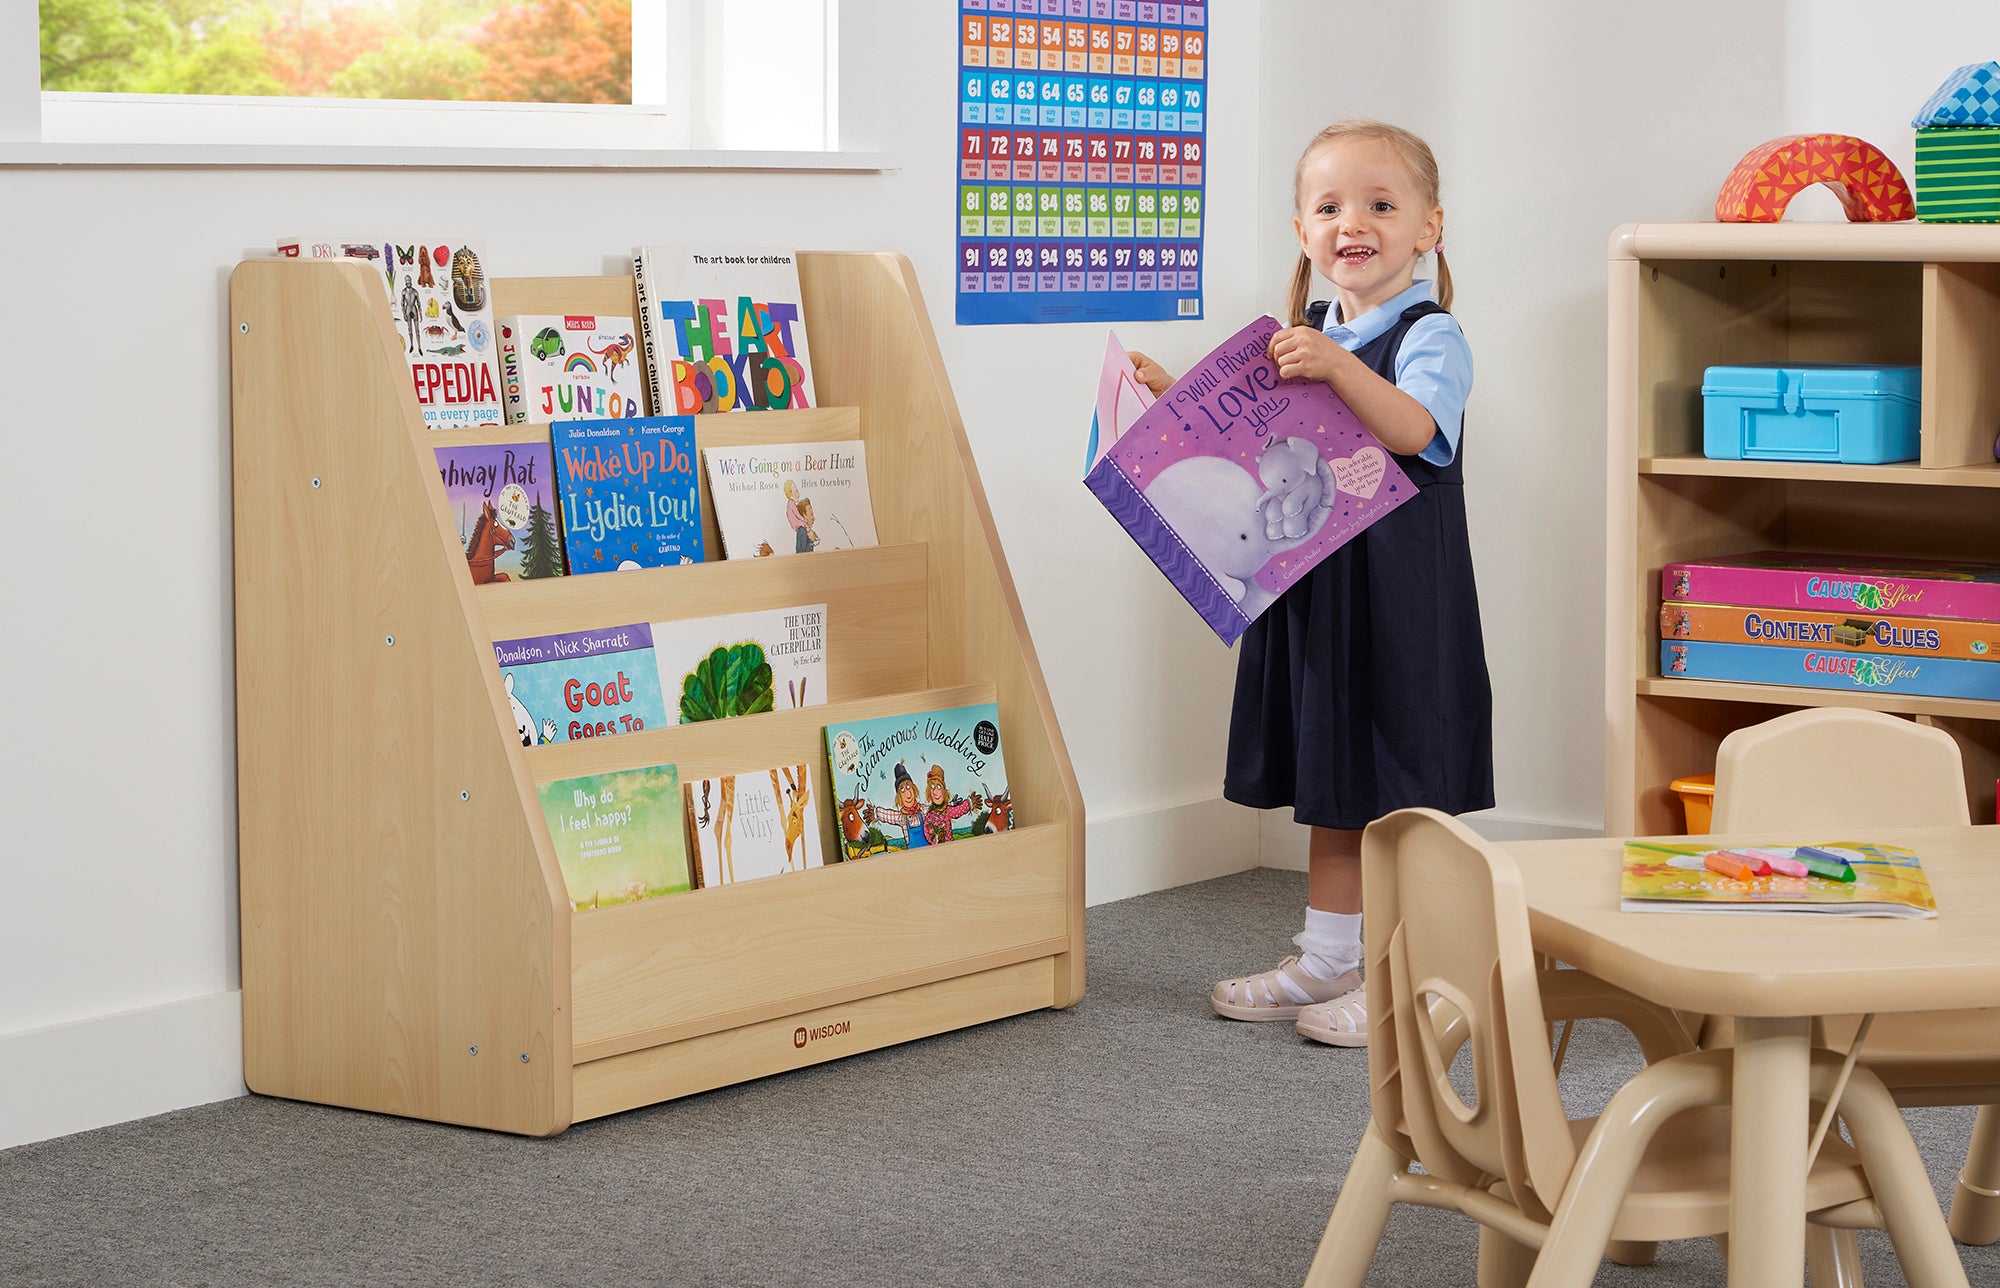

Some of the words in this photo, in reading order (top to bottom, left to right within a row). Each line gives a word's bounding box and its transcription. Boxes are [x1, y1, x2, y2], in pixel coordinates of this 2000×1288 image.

[969, 22, 981, 40] 51
[993, 24, 1010, 42] 52
[1019, 26, 1035, 43] 53
[1044, 27, 1060, 45] 54
[1069, 29, 1084, 47] 55
[1093, 31, 1109, 48] 56
[1118, 32, 1132, 50] 57
[1140, 34, 1155, 51] 58
[1164, 36, 1178, 52] 59
[1185, 37, 1202, 54] 60
[968, 79, 980, 96] 61
[992, 80, 1009, 98] 62
[1017, 82, 1034, 99] 63
[1042, 83, 1060, 100] 64
[1068, 84, 1083, 102] 65
[1092, 86, 1108, 102] 66
[1116, 87, 1130, 103] 67
[1139, 88, 1154, 105] 68
[1162, 90, 1177, 106] 69
[1185, 91, 1200, 107] 70
[968, 136, 980, 153] 71
[992, 136, 1007, 154] 72
[1017, 137, 1033, 155] 73
[1043, 139, 1057, 155] 74
[1067, 140, 1082, 157] 75
[1091, 140, 1106, 157] 76
[1115, 142, 1130, 158] 77
[1139, 142, 1153, 159] 78
[1162, 143, 1177, 159] 79
[1184, 143, 1200, 161] 80
[967, 192, 979, 210] 81
[990, 192, 1007, 210] 82
[1016, 193, 1032, 211] 83
[1041, 194, 1058, 211] 84
[1066, 194, 1082, 212] 85
[1090, 195, 1107, 212] 86
[1115, 195, 1130, 212] 87
[1139, 196, 1154, 212] 88
[1162, 196, 1177, 213] 89
[1184, 197, 1199, 213] 90
[634, 256, 643, 280] The
[693, 255, 708, 264] The
[711, 256, 723, 264] art
[725, 255, 745, 264] book
[747, 255, 758, 264] for
[760, 255, 791, 264] children
[966, 249, 978, 266] 91
[990, 248, 1007, 266] 92
[1016, 249, 1032, 266] 93
[1041, 249, 1058, 266] 94
[1066, 249, 1082, 267] 95
[1090, 249, 1107, 266] 96
[1115, 249, 1131, 265] 97
[1139, 249, 1154, 266] 98
[1161, 249, 1175, 265] 99
[1180, 250, 1197, 266] 100
[638, 283, 646, 302] art
[641, 306, 651, 339] book
[661, 298, 732, 362] THE
[738, 296, 798, 358] ART
[645, 340, 654, 361] for
[504, 345, 520, 404] JUNIOR
[671, 354, 755, 415] BOOK
[748, 352, 810, 410] FOR
[542, 384, 637, 419] JUNIOR
[649, 364, 661, 414] children
[1166, 402, 1183, 421] I
[1176, 368, 1221, 403] Will
[424, 411, 437, 421] on
[440, 409, 469, 422] every
[473, 408, 499, 422] page
[1243, 397, 1290, 437] you
[569, 429, 585, 438] Julia
[587, 427, 620, 437] Donaldson
[641, 425, 661, 434] Karen
[662, 425, 685, 436] George
[503, 450, 537, 485] Rat
[561, 445, 622, 482] Wake
[621, 441, 655, 484] Up
[659, 439, 692, 476] Do,
[719, 459, 746, 476] We're
[749, 456, 780, 478] Going
[781, 462, 793, 473] on
[795, 462, 801, 472] a
[804, 454, 828, 471] Bear
[829, 453, 856, 470] Hunt
[1337, 471, 1353, 481] book
[1362, 460, 1379, 471] share
[1349, 453, 1372, 468] adorable
[728, 481, 757, 492] Michael
[759, 481, 779, 491] Rosen
[801, 479, 818, 489] Helen
[820, 477, 851, 489] Oxenbury
[1343, 478, 1357, 488] with
[1357, 467, 1382, 482] someone
[1354, 484, 1365, 495] you
[1366, 478, 1379, 486] love
[568, 492, 644, 542] Lydia
[648, 487, 696, 527] Lou!
[1807, 577, 1860, 600] CAUSE
[1875, 581, 1924, 610] Effect
[784, 615, 800, 628] THE
[801, 612, 822, 625] VERY
[1744, 612, 1834, 643] CONTEXT
[1874, 620, 1940, 649] CLUES
[789, 625, 821, 641] HUNGRY
[496, 646, 543, 664] Donaldson
[553, 640, 580, 657] Nick
[582, 632, 629, 653] Sharratt
[770, 638, 821, 656] CATERPILLAR
[1804, 652, 1858, 675] CAUSE
[1872, 657, 1920, 686] Effect
[564, 671, 633, 713] Goat
[568, 720, 617, 741] Goes
[620, 713, 644, 731] To
[858, 731, 875, 756] The
[924, 717, 986, 777] Wedding
[573, 789, 596, 808] Why
[600, 788, 614, 804] do
[736, 790, 770, 816] Little
[560, 814, 565, 832] I
[569, 812, 591, 832] feel
[594, 804, 632, 828] happy?
[740, 816, 774, 843] Why
[809, 1020, 851, 1041] WISDOM
